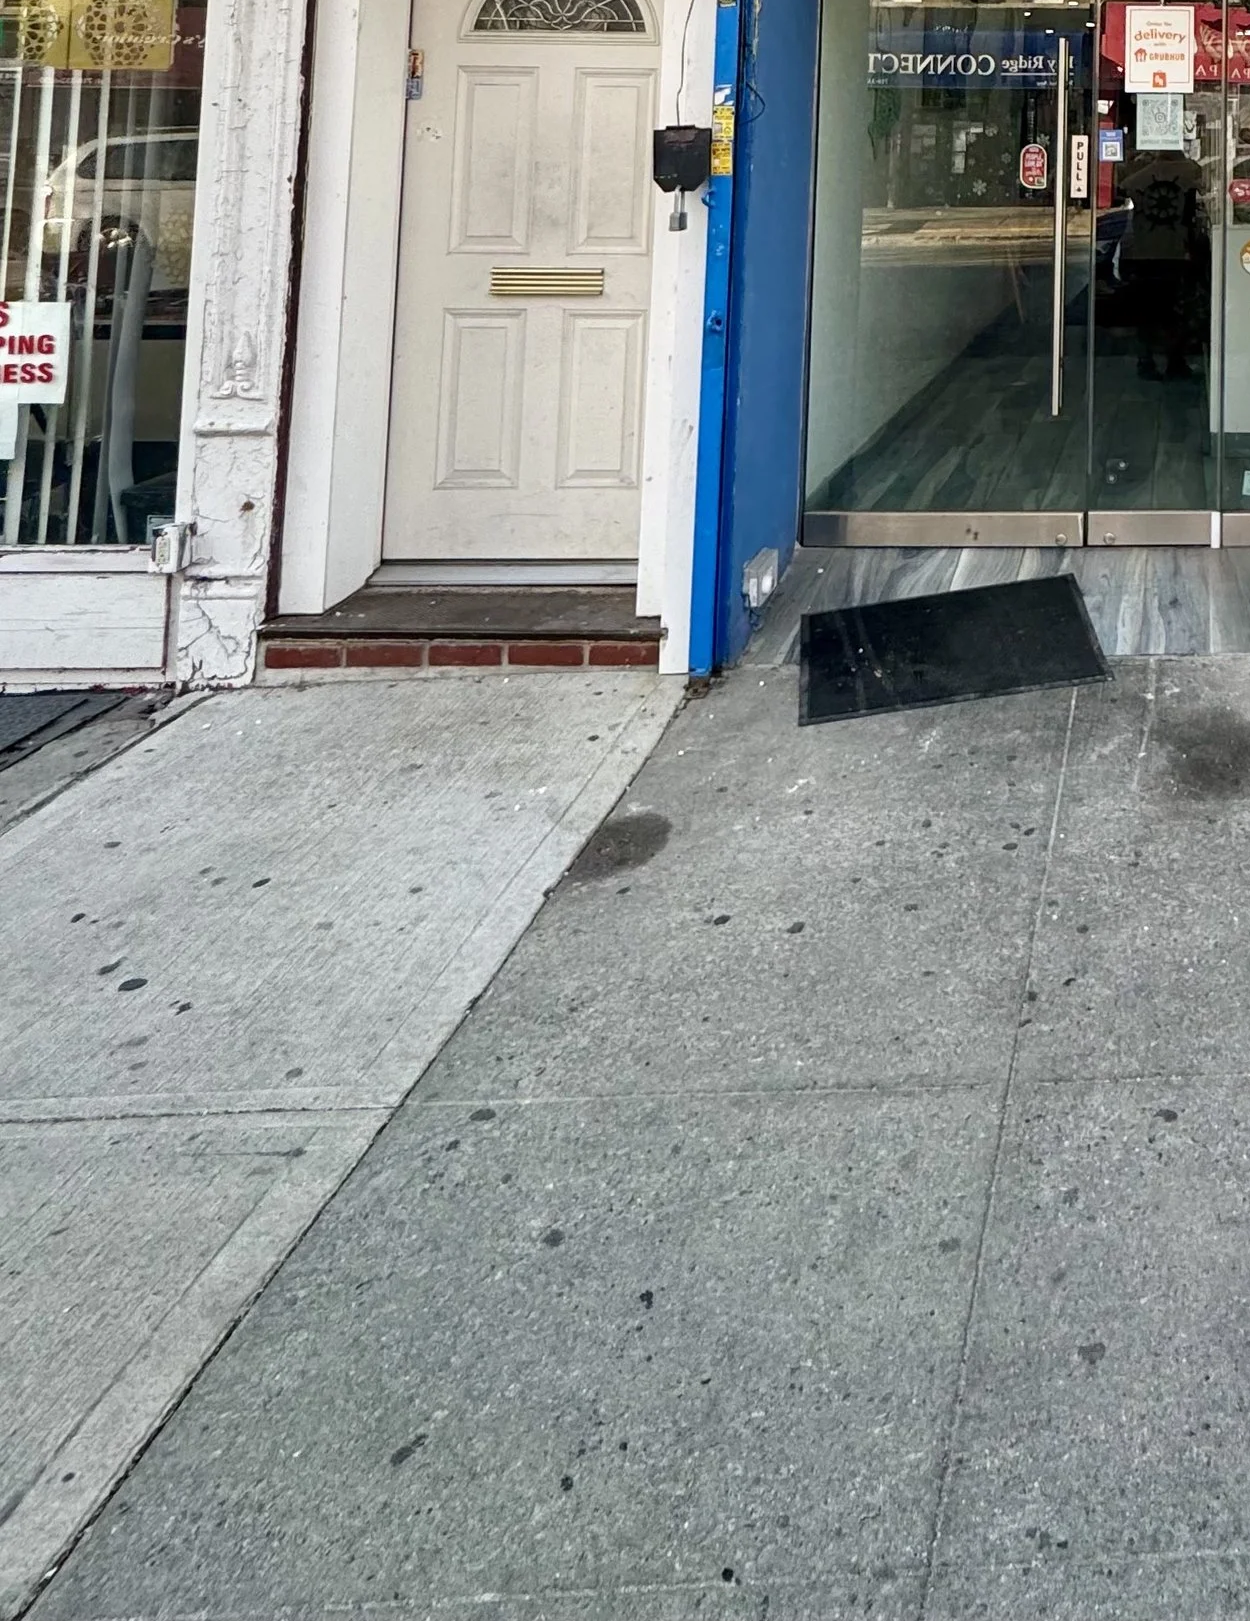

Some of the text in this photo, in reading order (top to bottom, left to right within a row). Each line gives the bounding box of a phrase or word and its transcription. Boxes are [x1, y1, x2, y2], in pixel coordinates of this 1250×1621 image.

[1134, 28, 1186, 44] delivery
[1149, 52, 1185, 61] GRUBHUB
[1076, 141, 1084, 181] PULL
